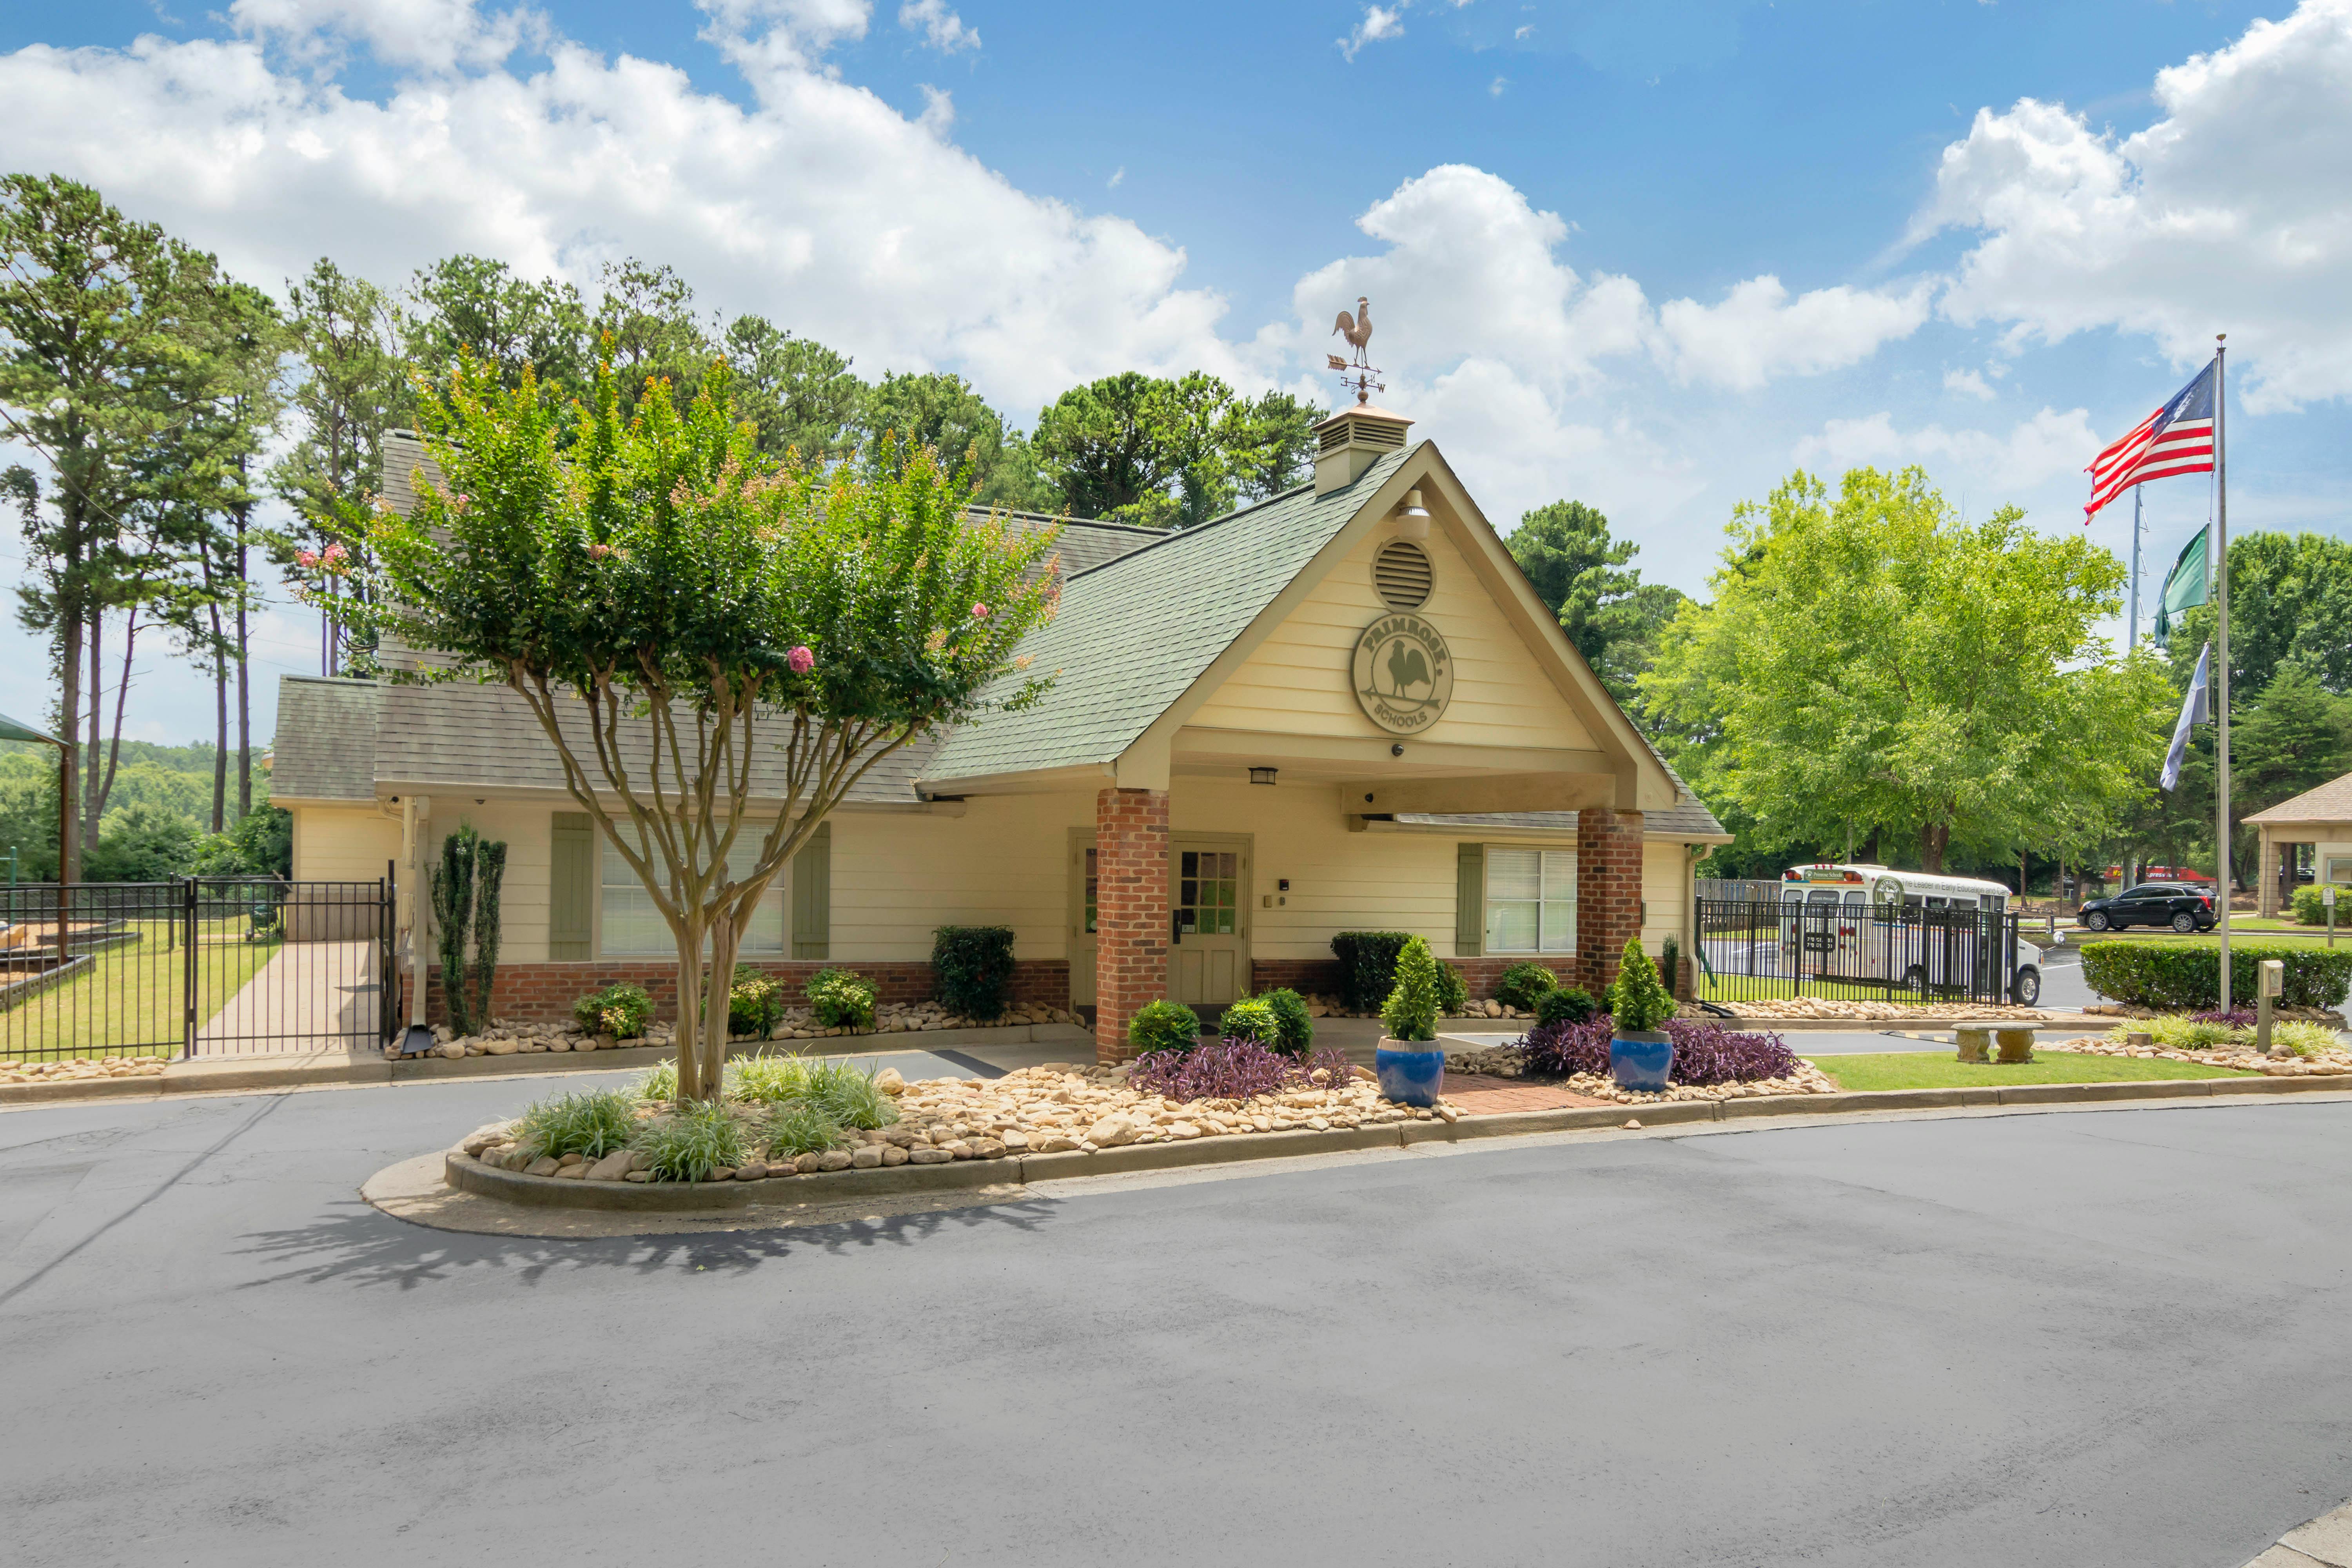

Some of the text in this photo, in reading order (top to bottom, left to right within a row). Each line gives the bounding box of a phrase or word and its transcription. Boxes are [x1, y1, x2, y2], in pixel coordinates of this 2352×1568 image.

[1377, 383, 1386, 393] W
[1362, 617, 1446, 664] PRIMROSE
[1374, 703, 1427, 727] SCHOOLS
[1914, 880, 1933, 889] Leader
[1941, 882, 1955, 893] Early
[1957, 884, 1984, 893] Education
[1997, 887, 2010, 897] Care
